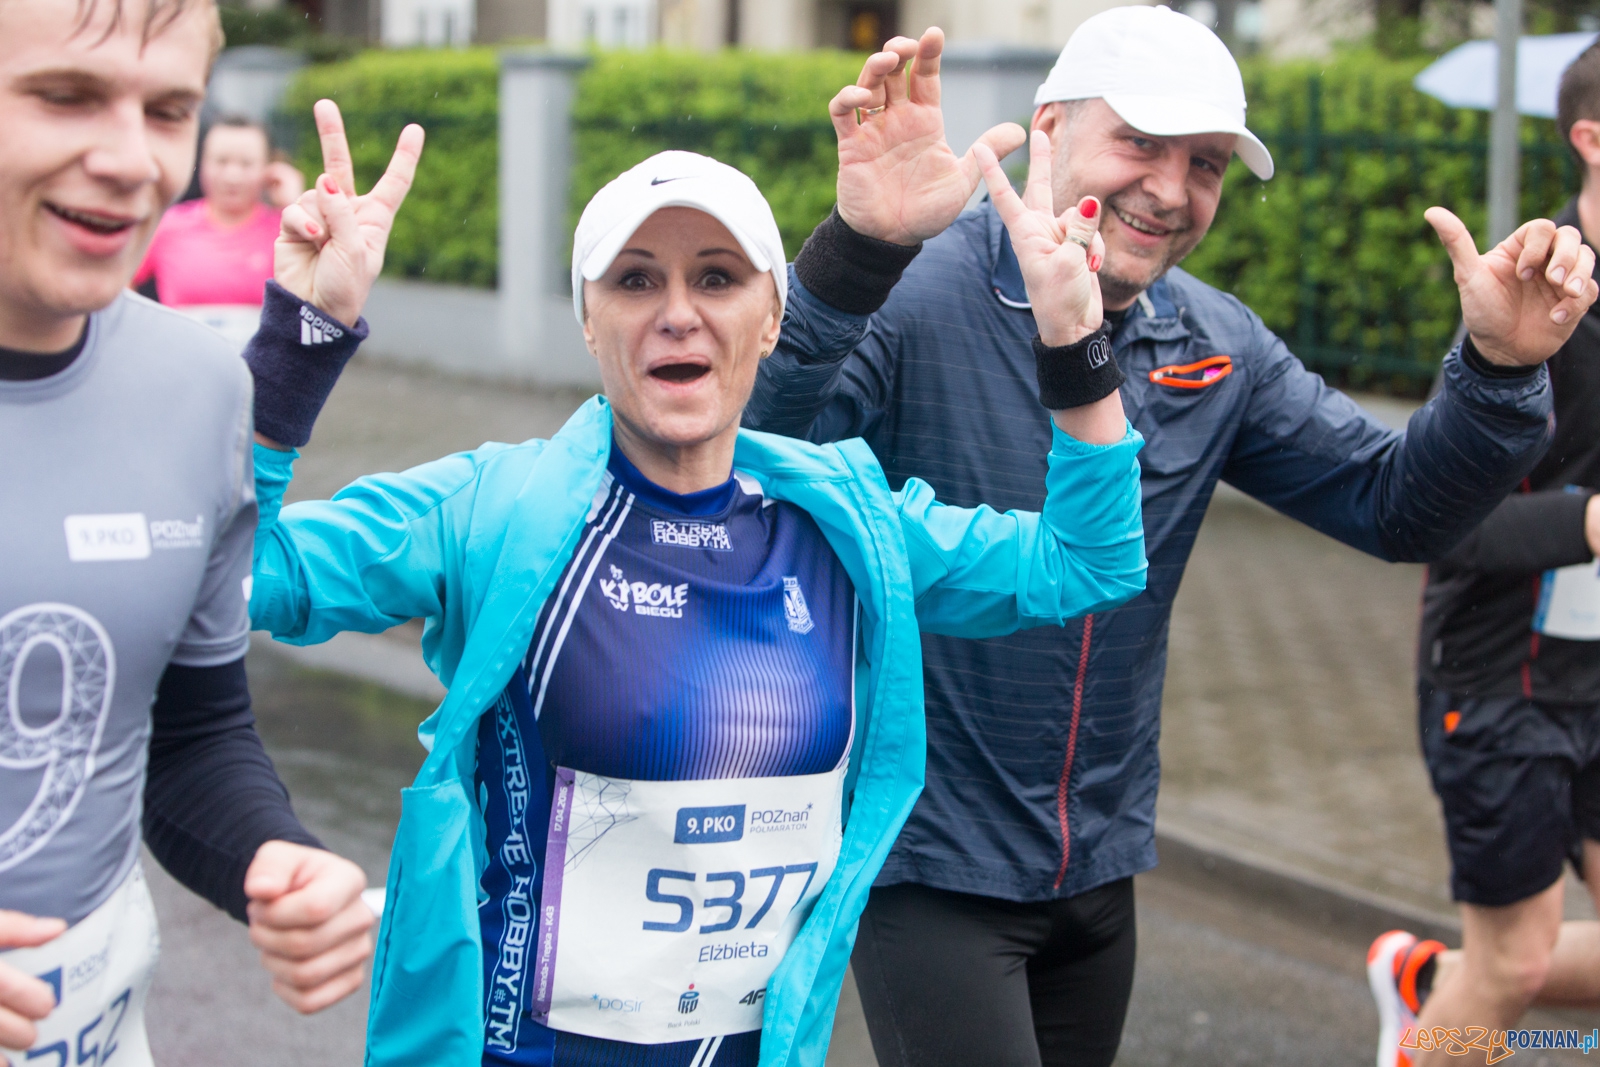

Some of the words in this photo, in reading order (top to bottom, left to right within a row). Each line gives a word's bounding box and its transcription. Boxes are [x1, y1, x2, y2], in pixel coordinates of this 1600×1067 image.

[299, 305, 344, 338] adidas
[652, 521, 728, 538] EXTREME
[634, 604, 683, 619] BIEGU
[703, 815, 736, 834] PKO
[545, 905, 555, 926] K43
[698, 941, 769, 963] Elżbieta
